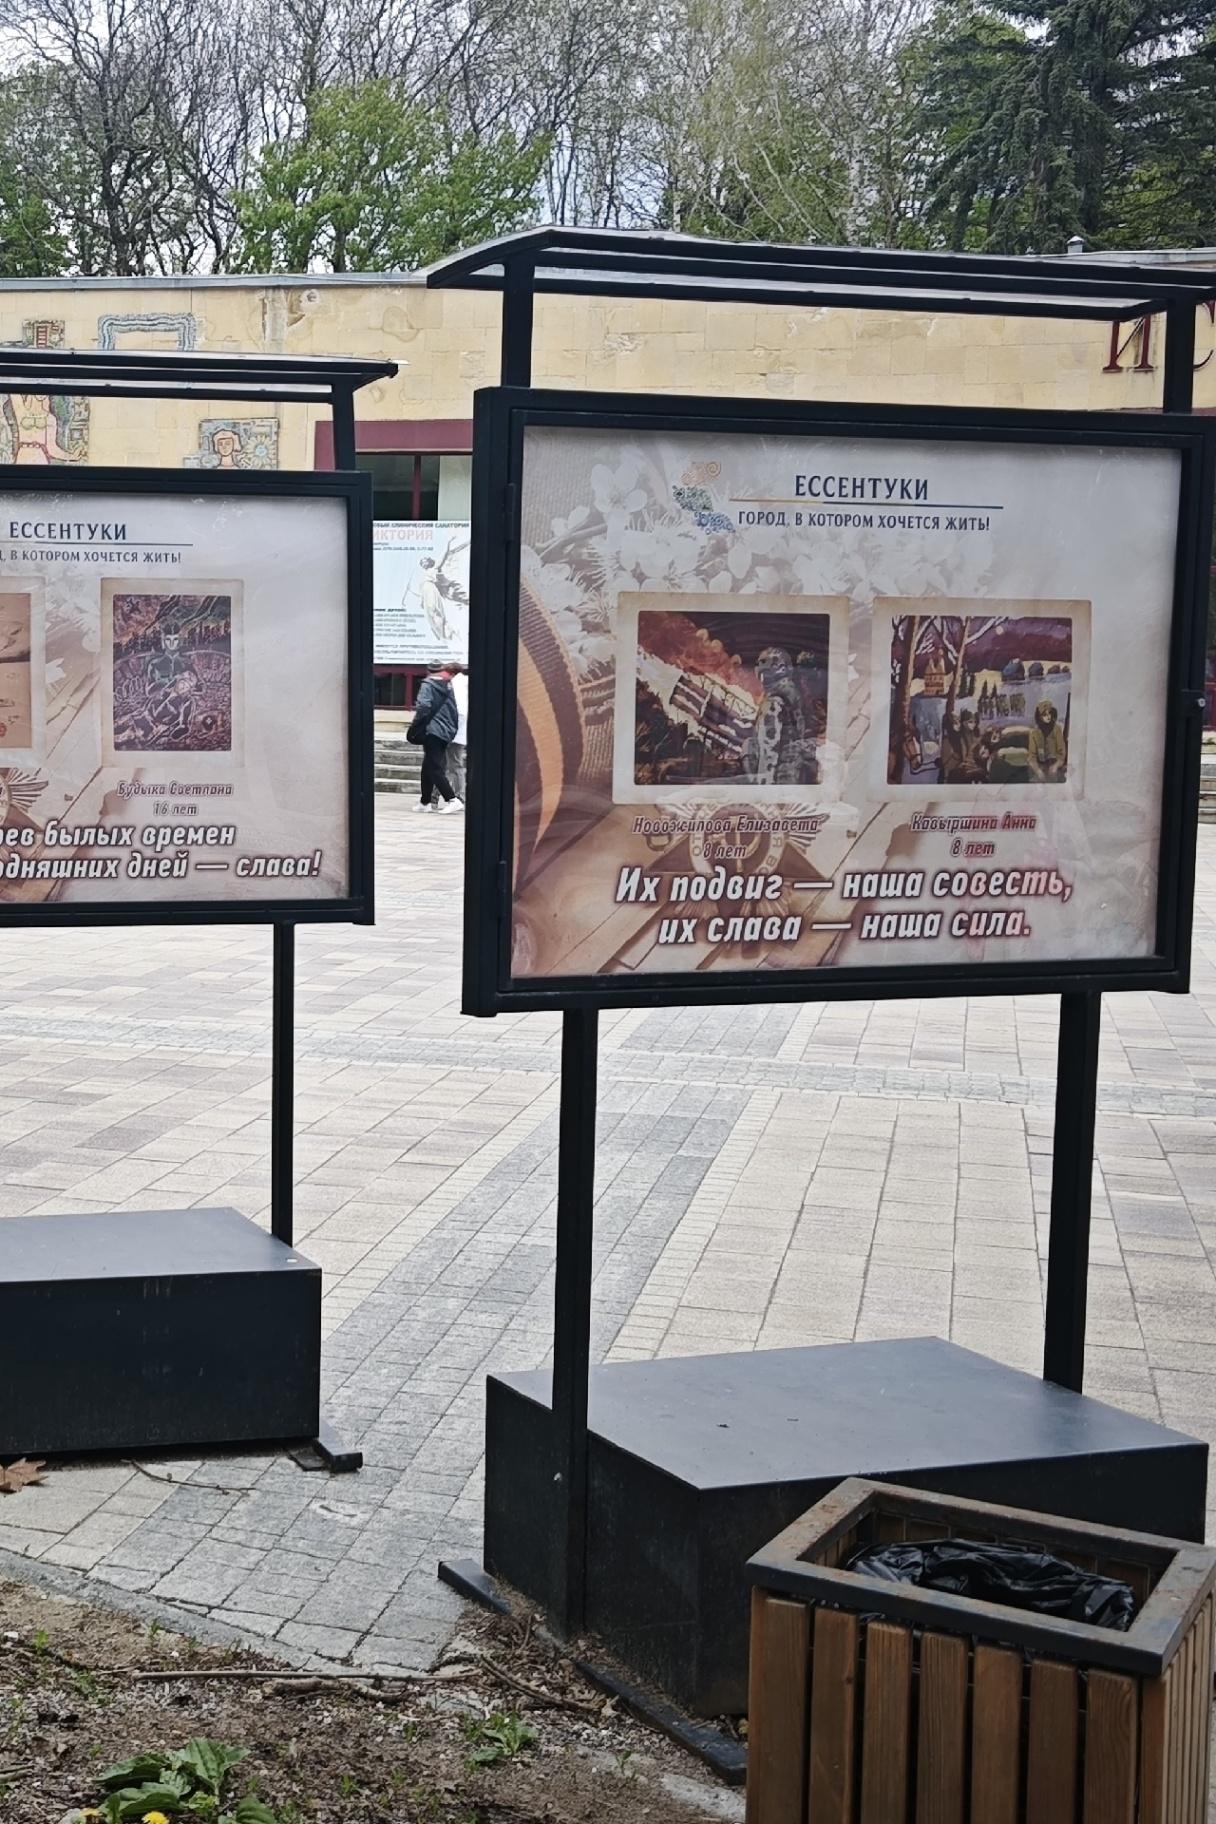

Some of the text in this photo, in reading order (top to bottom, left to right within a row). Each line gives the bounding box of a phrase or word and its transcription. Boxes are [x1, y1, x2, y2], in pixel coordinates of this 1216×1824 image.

[794, 475, 928, 500] ЕССЕНТУКИ
[9, 521, 126, 540] ЕССЕНТУКИ
[738, 511, 990, 531] ГОРОД, В КОТОРОМ ХОЧЕТСЯ ЖИТЬ!
[11, 550, 18, 561] В
[23, 550, 80, 562] КОТОРОМ
[84, 551, 138, 562] ХОЧЕТСЯ
[143, 552, 181, 563] ЖИТЬ!
[117, 781, 233, 799] Будыка Светлана
[154, 803, 198, 815] 16 лет
[633, 814, 820, 833] Новожилова Елизавета
[1002, 811, 1037, 830] Анна
[44, 820, 133, 846] былых
[142, 825, 236, 852] времен
[703, 841, 747, 858] 8 лет
[951, 839, 995, 856] 8 лет
[127, 851, 188, 878] дней
[236, 850, 322, 877] слава!
[616, 867, 661, 902] Их
[670, 866, 783, 901] подвиг
[842, 871, 925, 898] наша
[932, 869, 1073, 902] совесть,
[658, 917, 699, 944] их
[707, 916, 801, 943] слава
[860, 912, 942, 939] наша
[951, 910, 1031, 937] сила.
